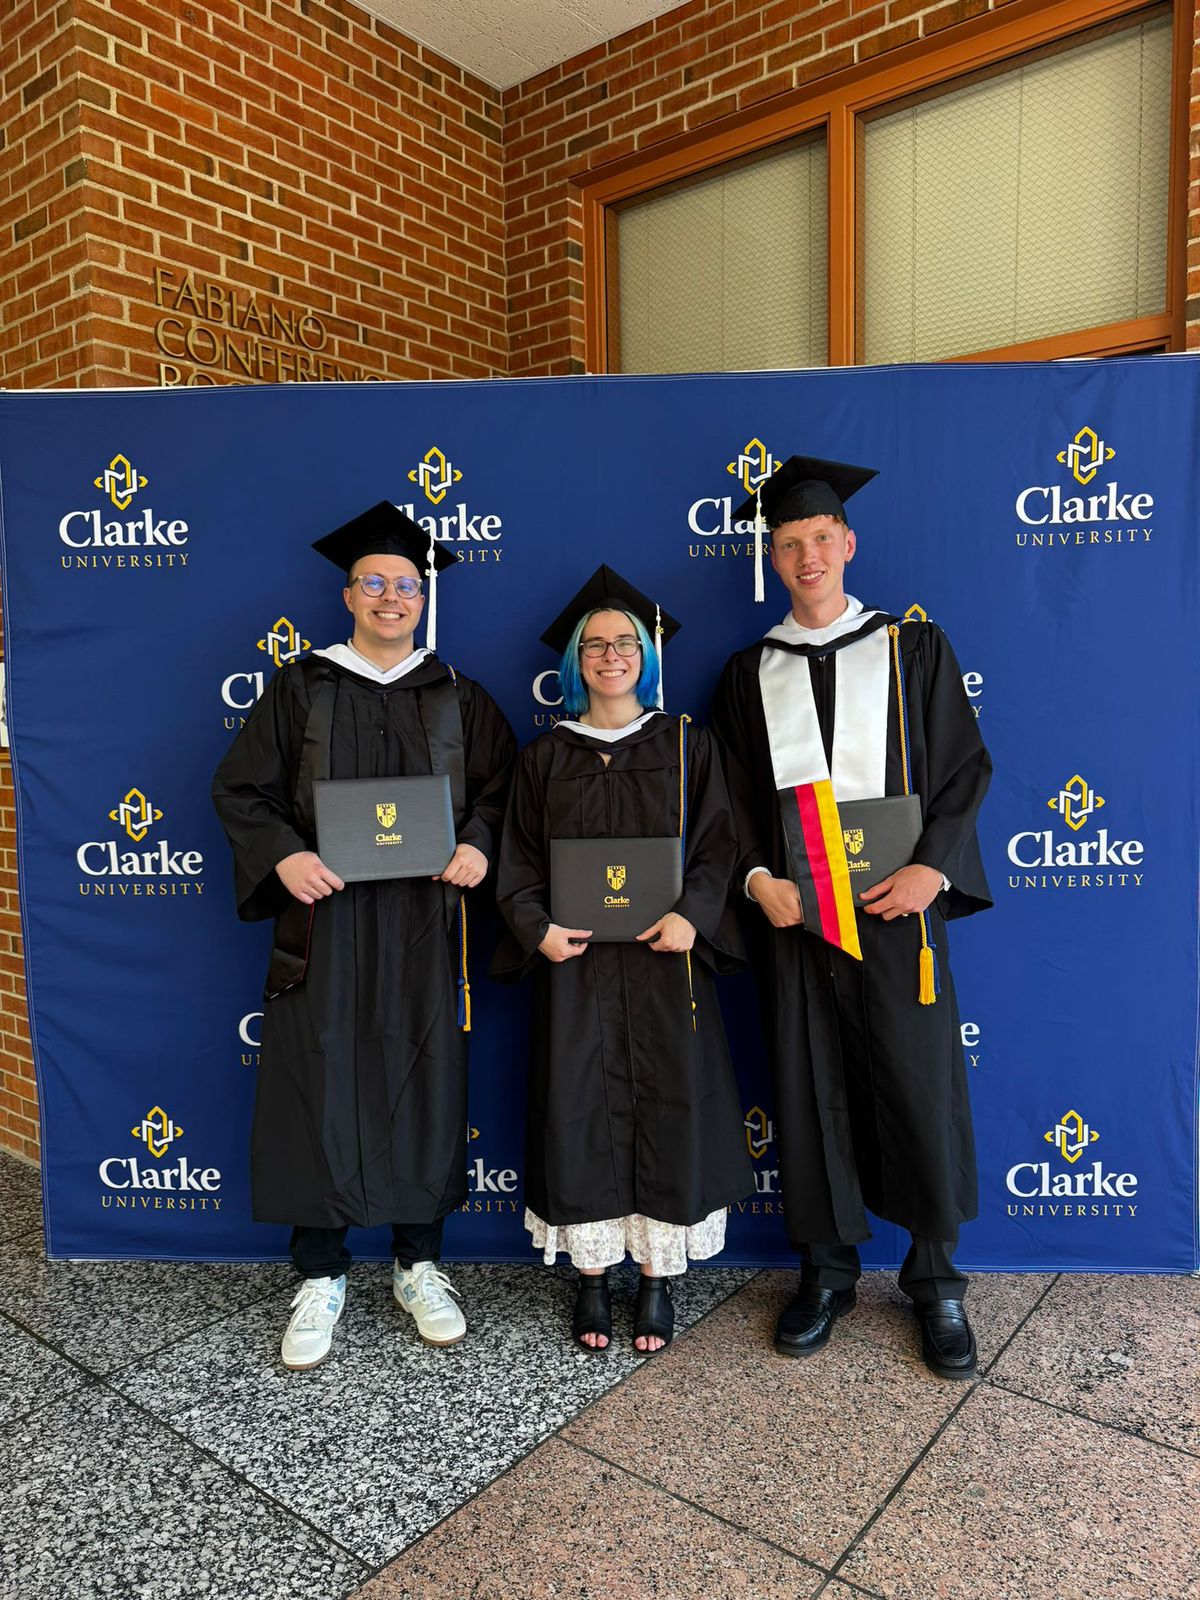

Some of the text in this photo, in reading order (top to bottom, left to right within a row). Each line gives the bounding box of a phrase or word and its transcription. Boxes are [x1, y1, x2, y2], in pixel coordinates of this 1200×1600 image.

[156, 267, 327, 350] FABIANO
[1016, 481, 1154, 525] Clarke
[59, 508, 189, 547] Clarke
[395, 503, 502, 541] arke
[1016, 528, 1154, 547] UNIVERSITY
[61, 553, 189, 568] UNIVERSITY
[689, 543, 769, 557] UNIVER
[76, 840, 203, 876] Clarke
[1007, 829, 1144, 868] Clarke
[79, 883, 204, 896] UNIVERSITY
[1008, 873, 1144, 888] UNIVERSITY
[98, 1157, 221, 1191] Clarke
[1006, 1162, 1138, 1197] Clarke
[101, 1196, 222, 1210] UNIVERSITY
[1007, 1205, 1138, 1217] UNIVERSITY
